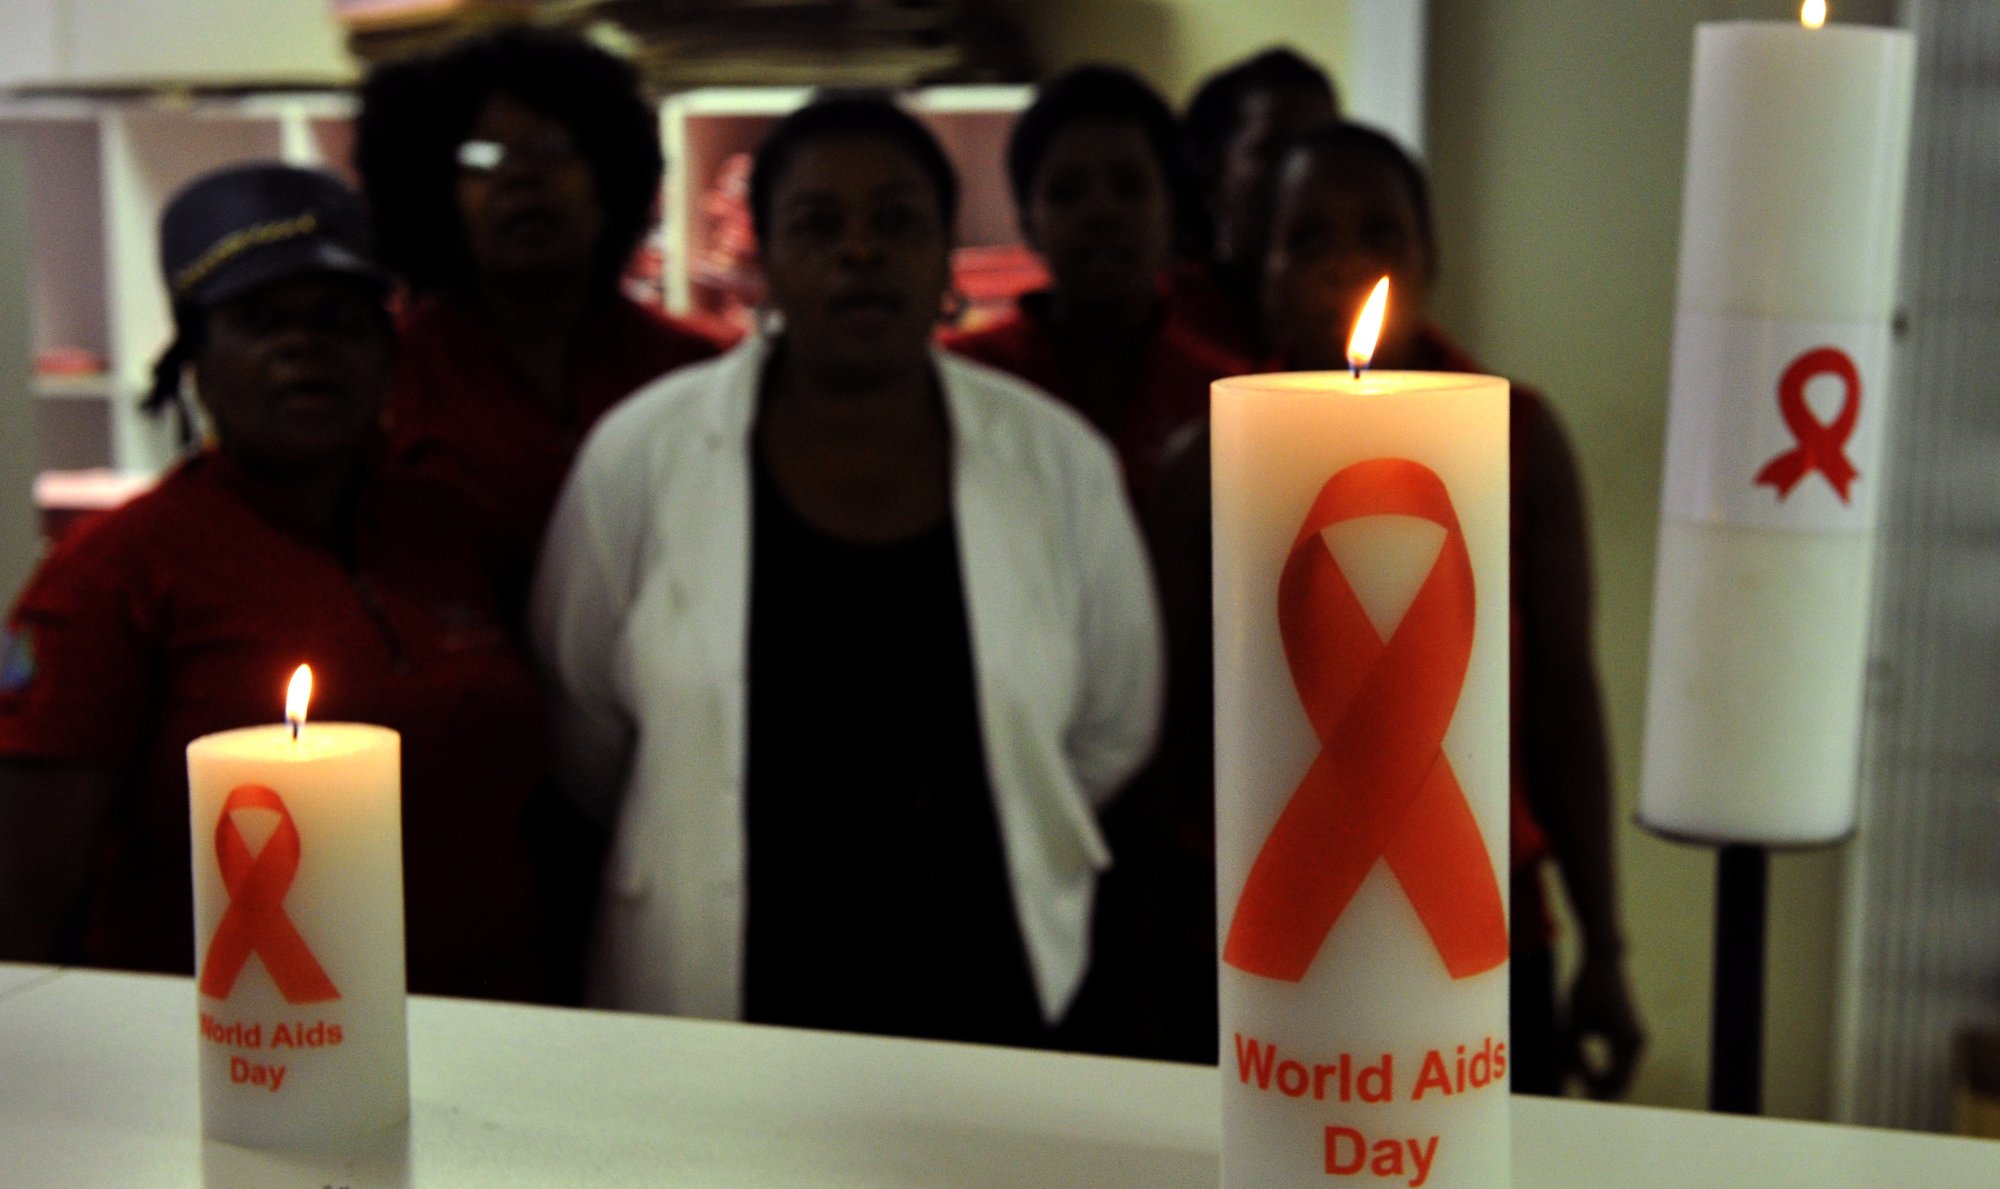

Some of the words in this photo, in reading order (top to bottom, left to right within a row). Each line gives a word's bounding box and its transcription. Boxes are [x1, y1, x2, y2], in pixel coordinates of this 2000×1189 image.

[271, 1021, 343, 1049] Aids
[230, 1056, 286, 1092] Day
[1234, 1031, 1393, 1103] World
[1410, 1034, 1506, 1101] Aids
[1324, 1125, 1439, 1188] Day
